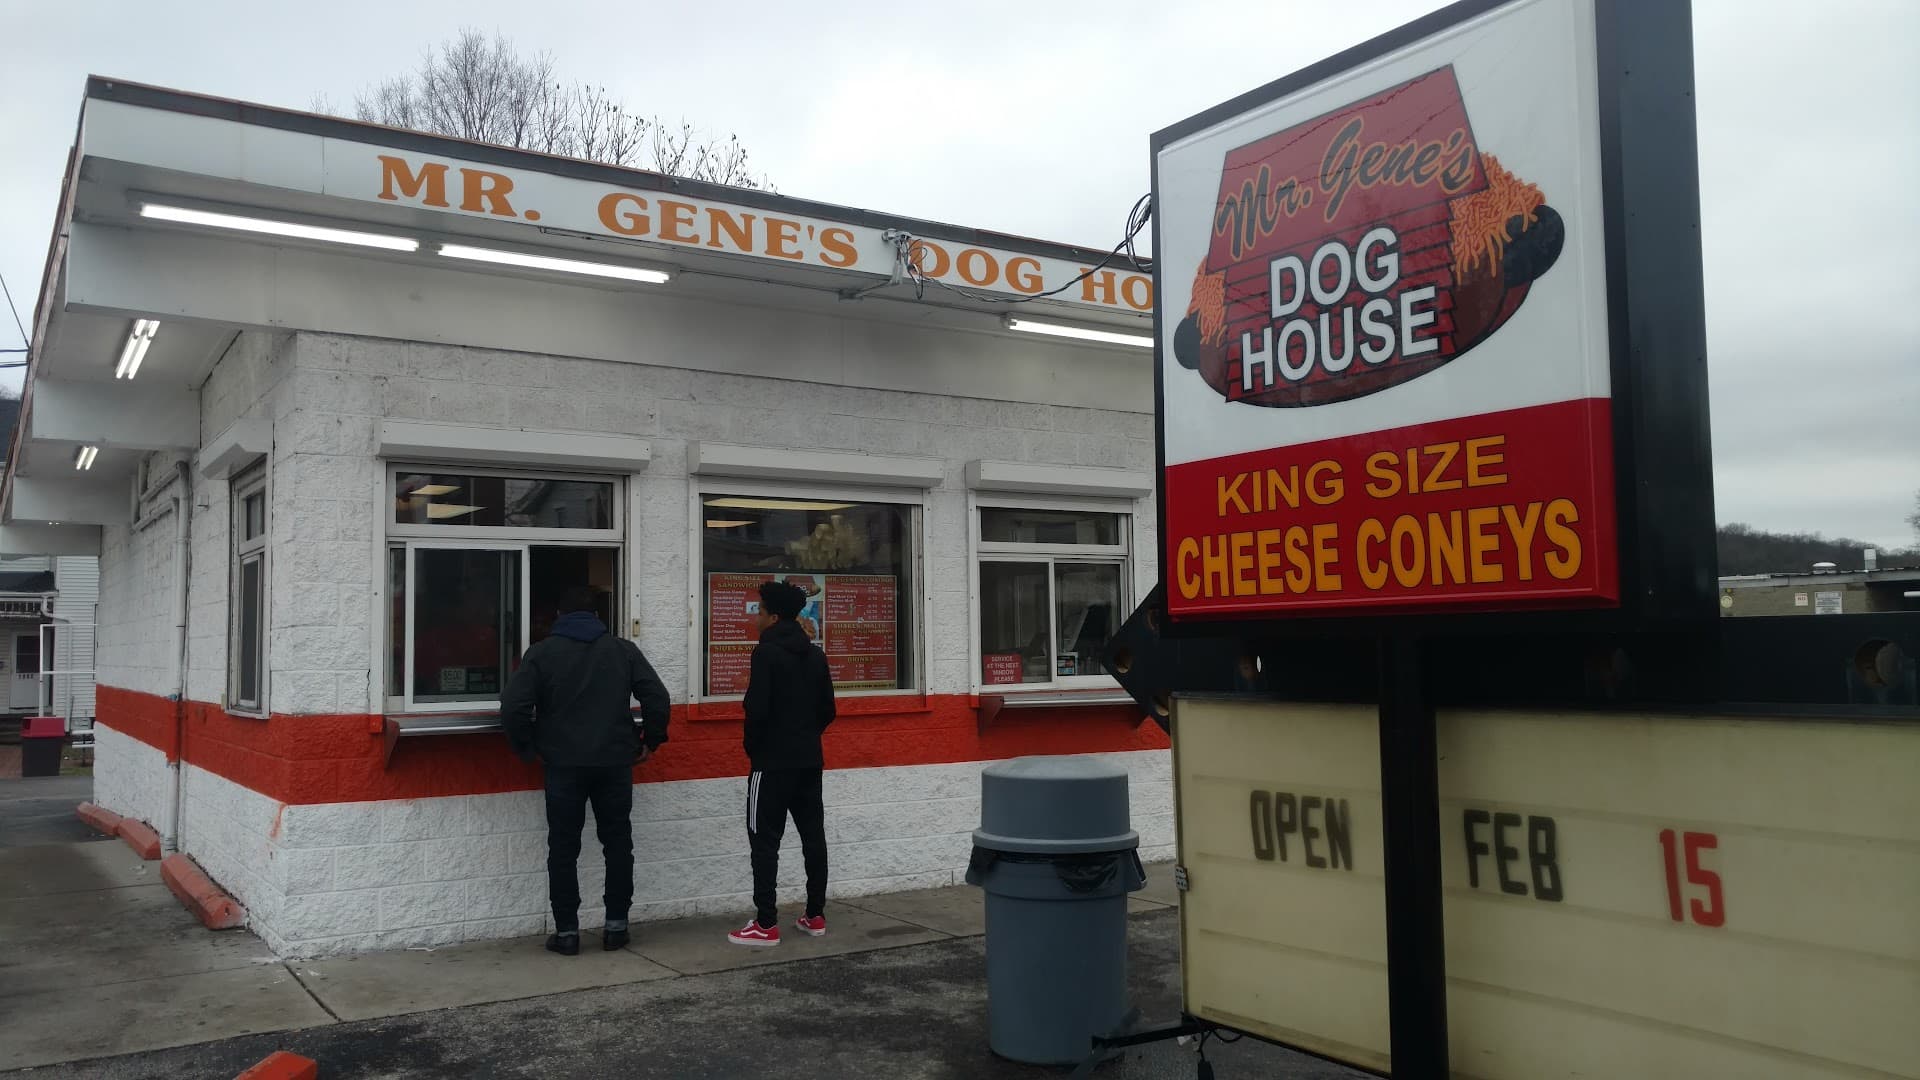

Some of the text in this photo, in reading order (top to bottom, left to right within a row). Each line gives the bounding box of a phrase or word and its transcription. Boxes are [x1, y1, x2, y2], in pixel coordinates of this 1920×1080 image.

[379, 156, 540, 221] MR.
[598, 193, 858, 268] GENE'S
[909, 239, 1044, 294] DOG
[1217, 117, 1475, 262] Mr. Gene's
[1269, 226, 1400, 319] DOG
[1242, 286, 1439, 391] HOUSE
[1217, 435, 1509, 517] KING SIZE
[1177, 498, 1582, 599] CHEESE CONEYS
[1250, 790, 1726, 928] OPEN FEB 15
